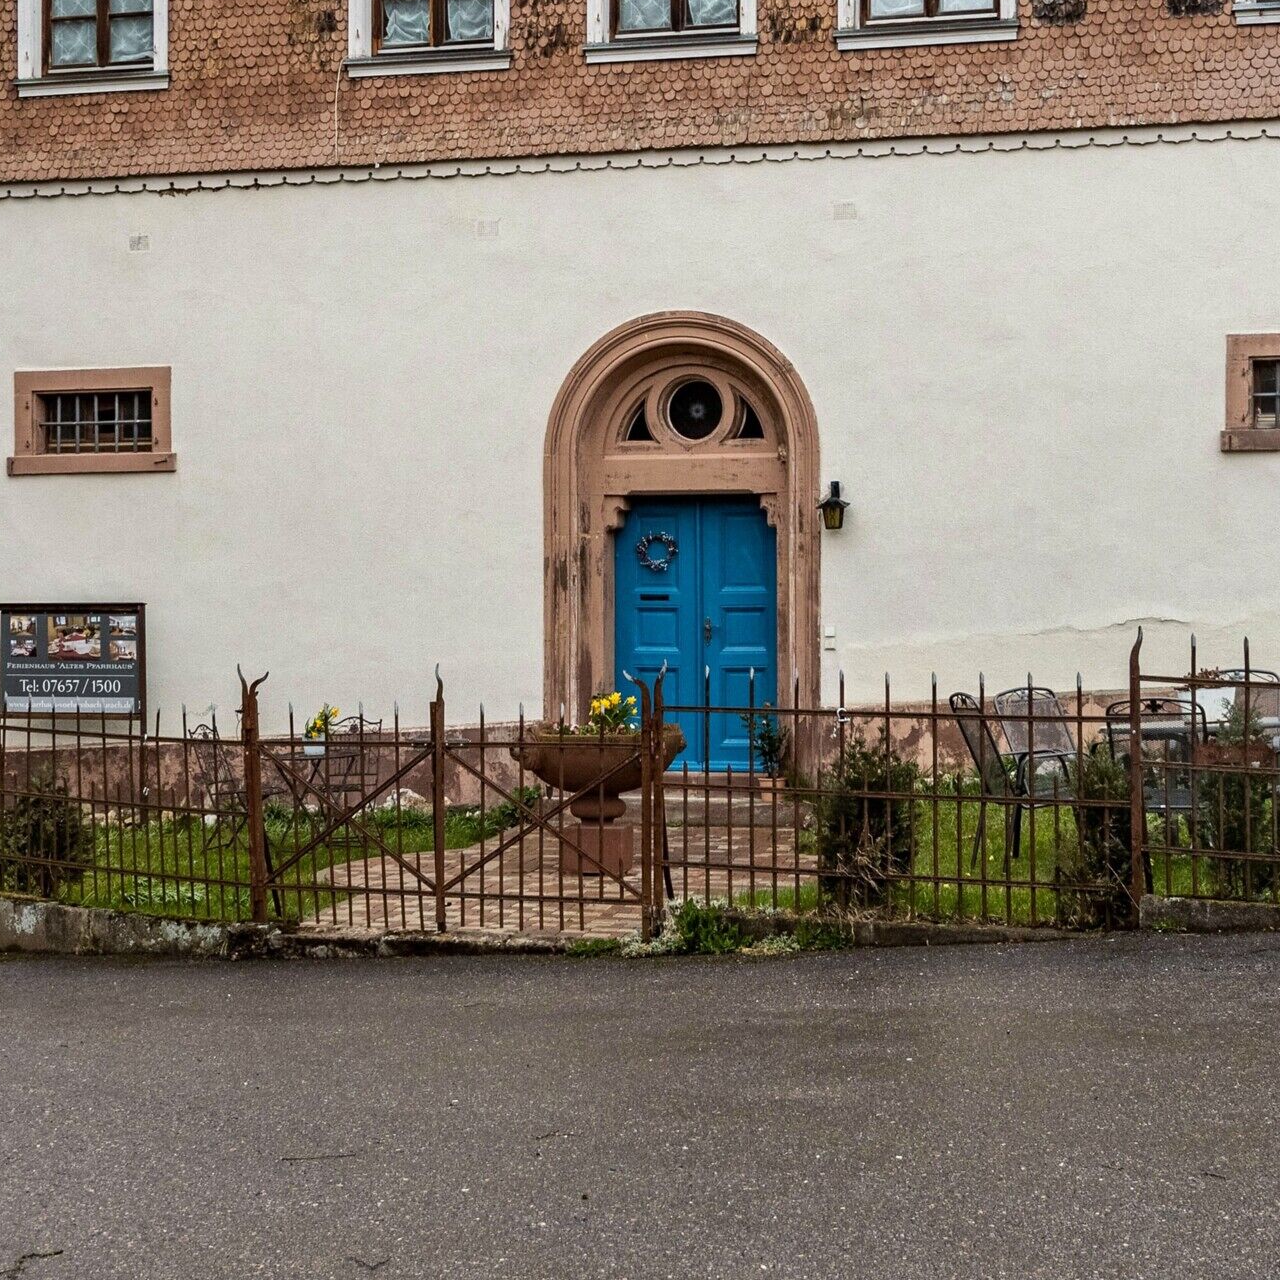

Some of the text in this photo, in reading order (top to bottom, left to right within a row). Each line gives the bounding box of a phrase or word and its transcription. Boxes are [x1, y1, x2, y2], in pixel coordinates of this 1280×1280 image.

[19, 678, 121, 695] Tel: 07657 / 1500
